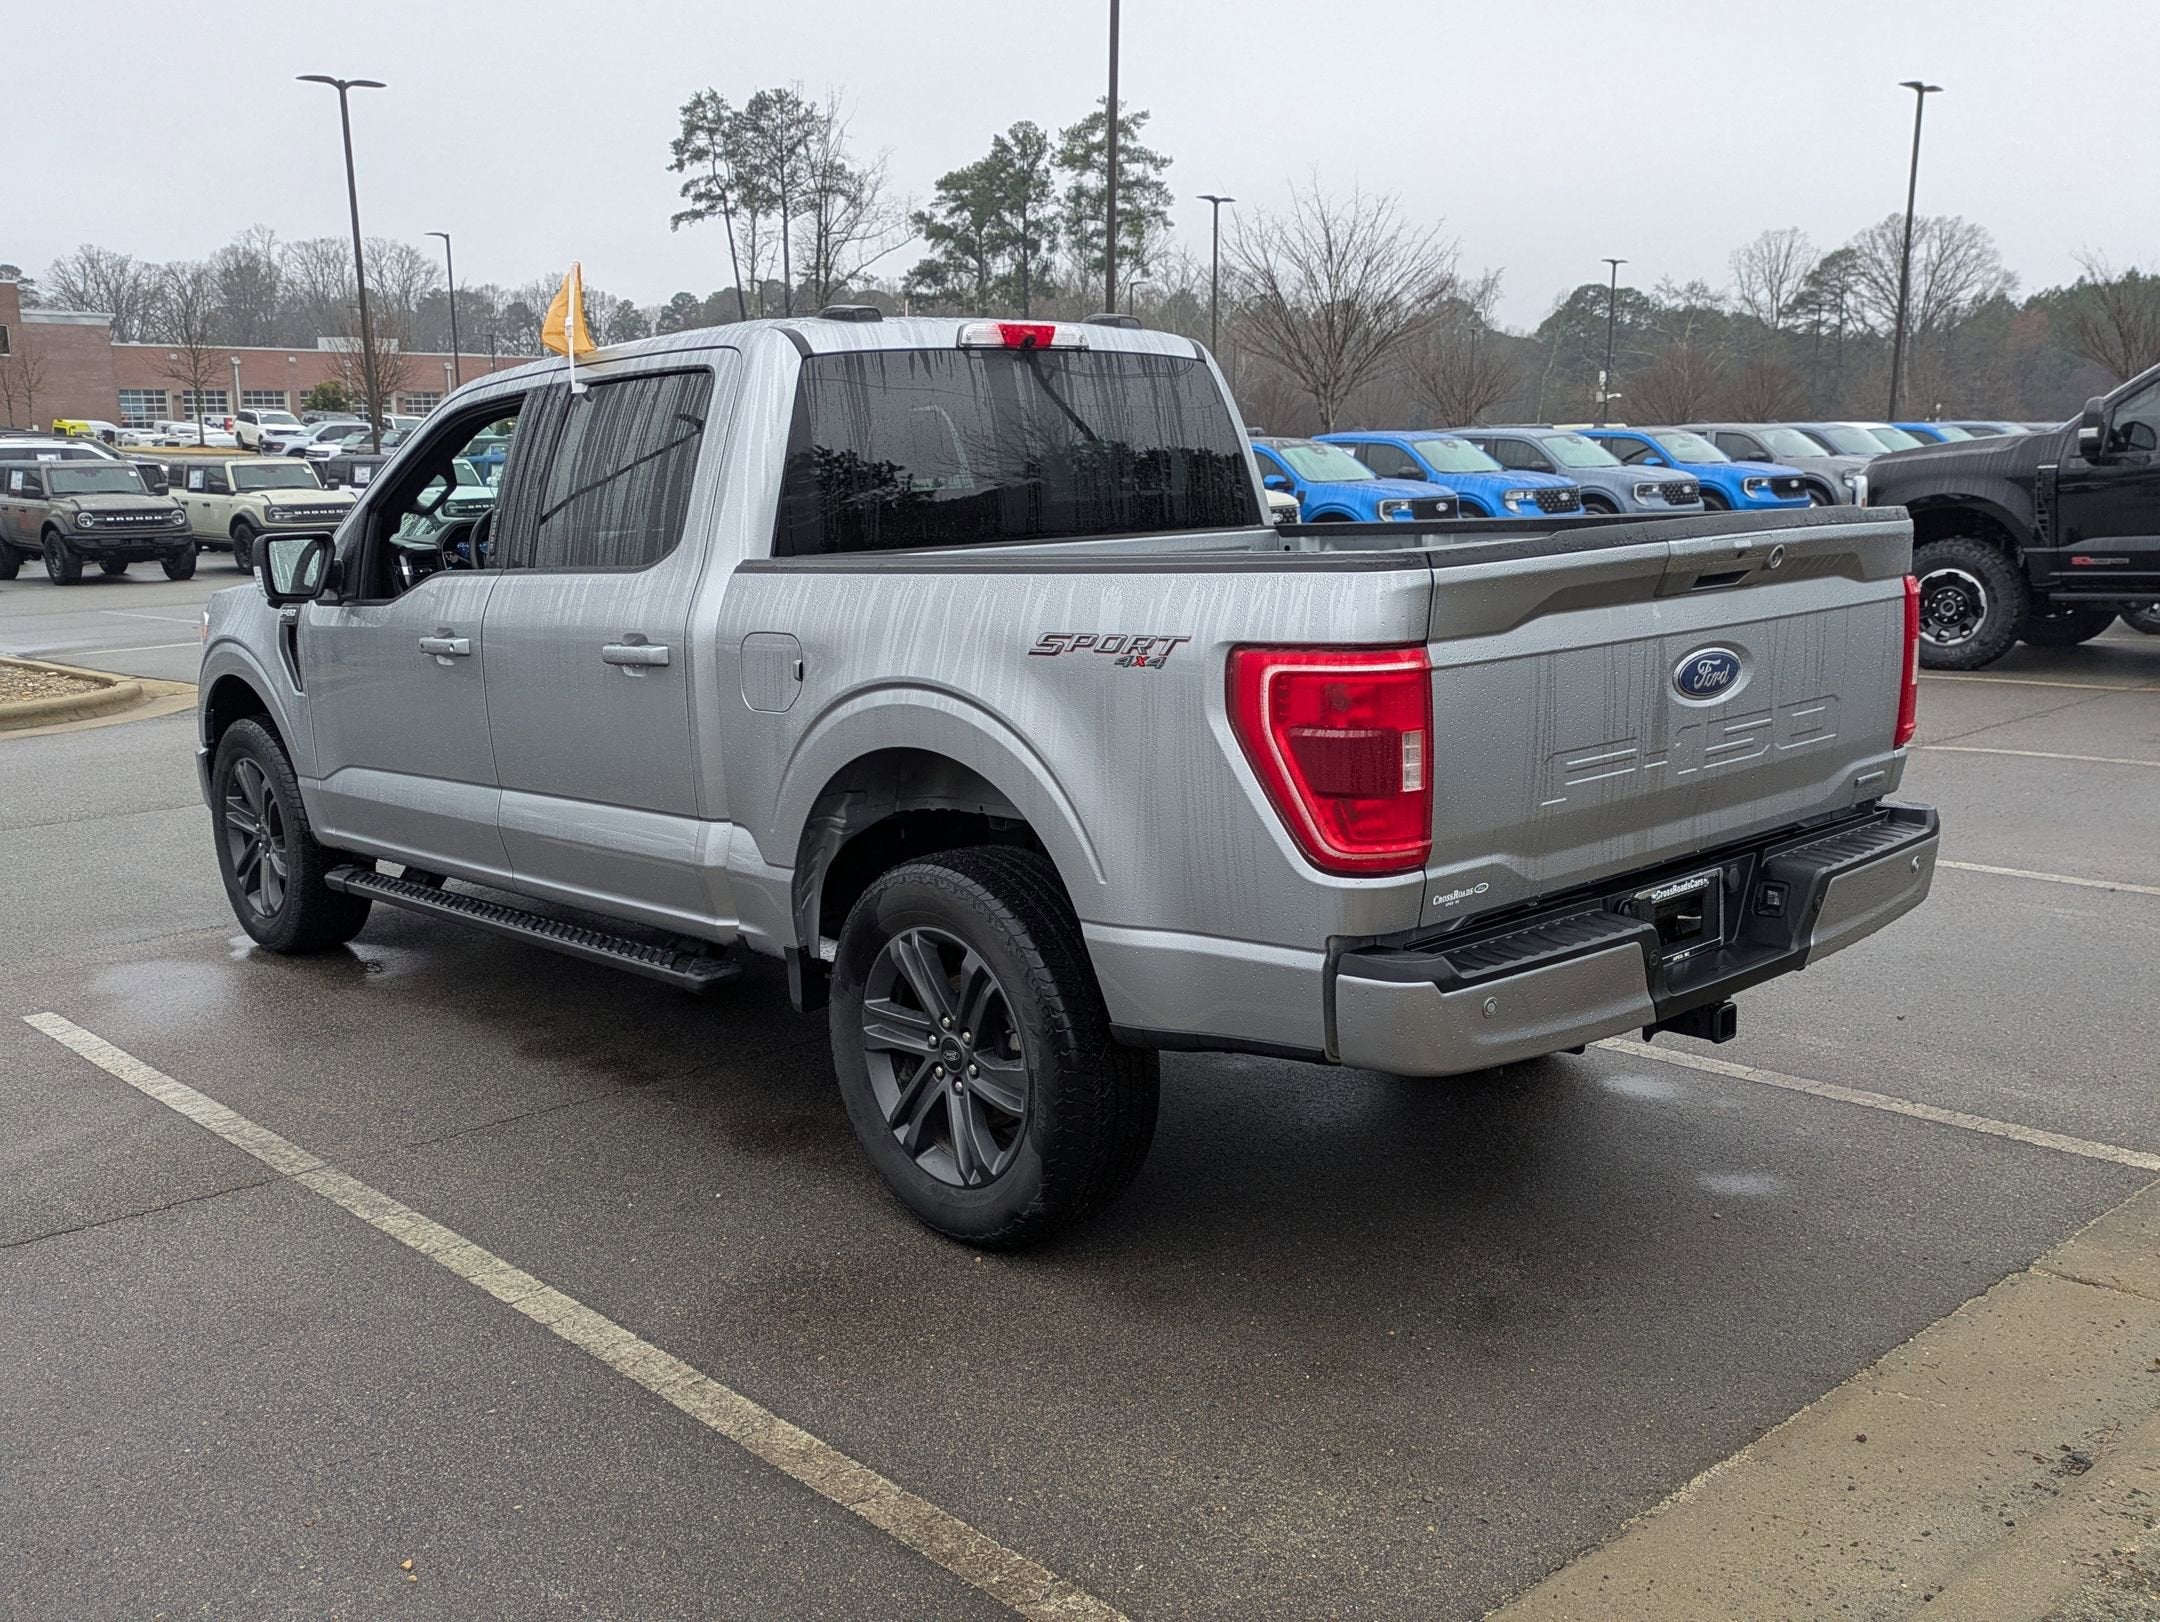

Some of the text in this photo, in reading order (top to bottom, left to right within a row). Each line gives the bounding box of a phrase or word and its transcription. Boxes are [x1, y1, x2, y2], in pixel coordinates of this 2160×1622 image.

[105, 514, 163, 522] BRONCO
[1028, 631, 1193, 656] SPORT
[1693, 658, 1731, 690] Ford
